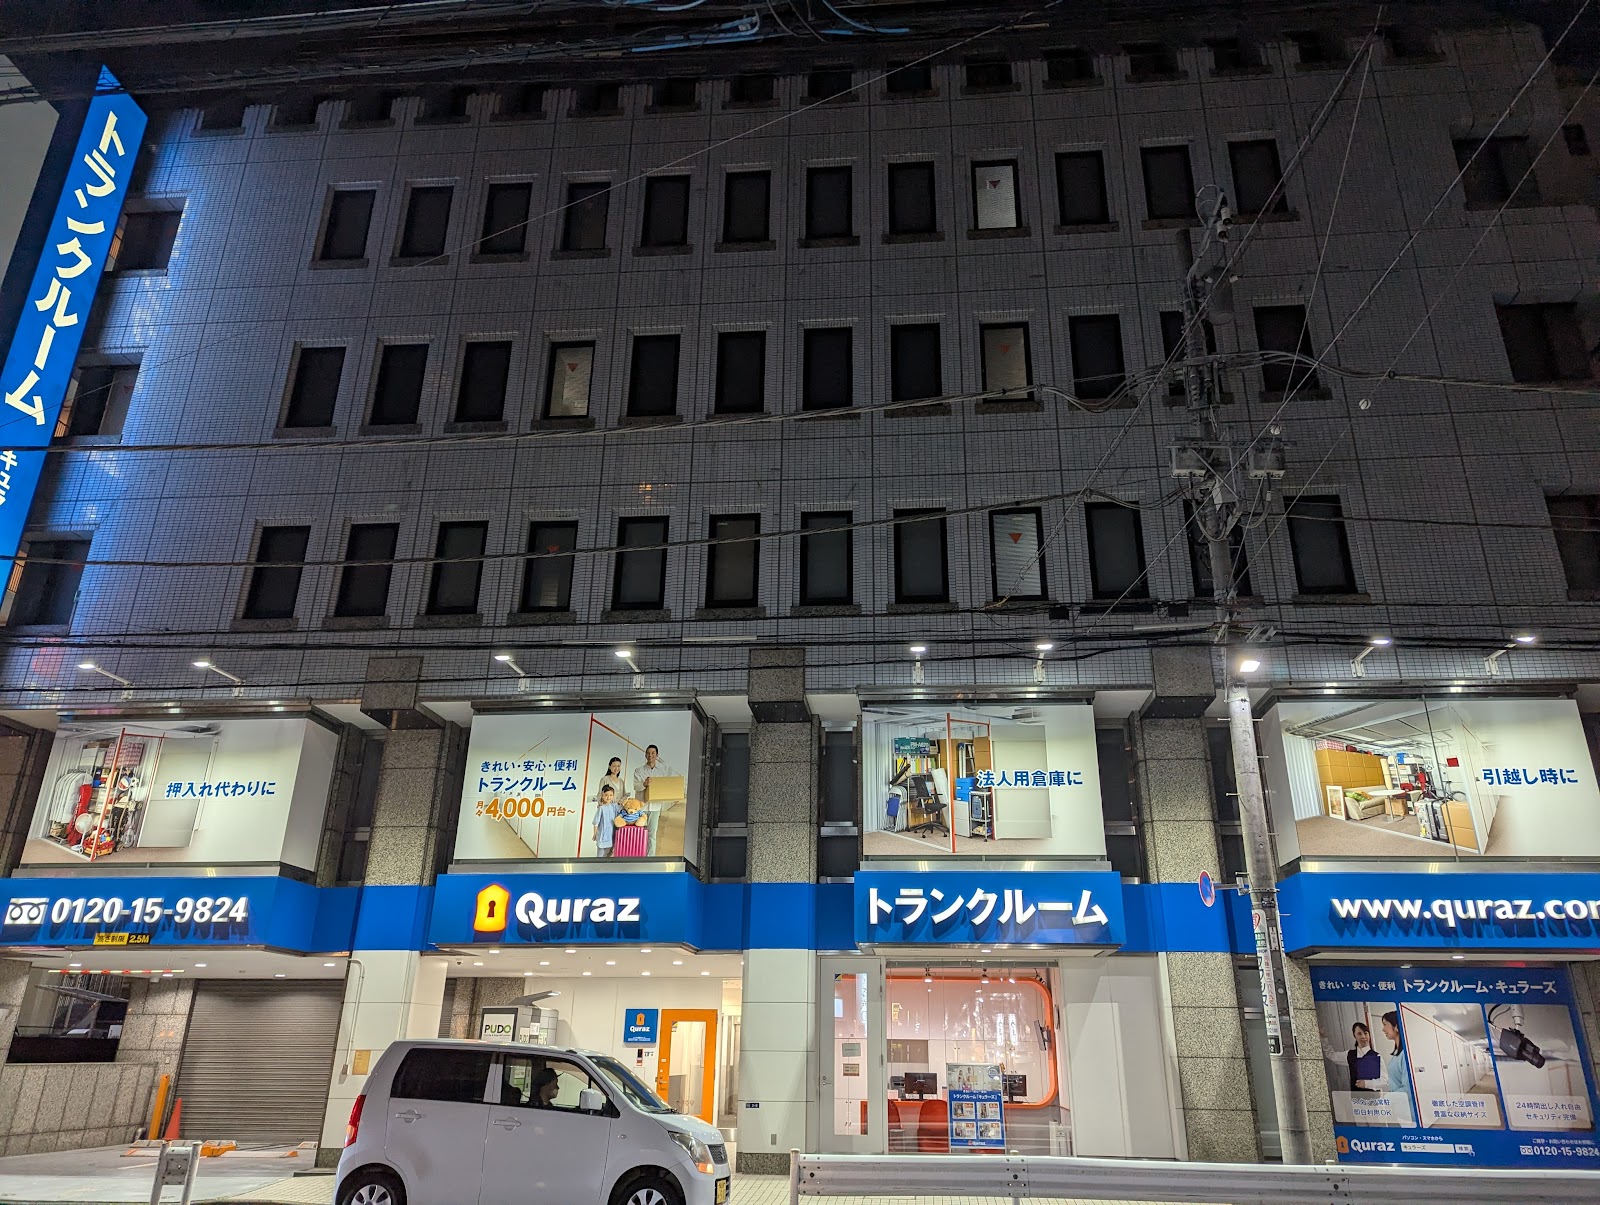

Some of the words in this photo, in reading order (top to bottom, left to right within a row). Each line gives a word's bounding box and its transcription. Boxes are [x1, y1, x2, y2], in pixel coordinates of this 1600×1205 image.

[5, 110, 125, 426] トランクルーム
[480, 759, 578, 773] きれい・安心・便利
[478, 776, 577, 793] トランクルーム
[977, 770, 1083, 788] 法人用倉庫に
[1482, 768, 1578, 786] 引越し時に
[165, 781, 277, 798] 押入れ代わりに
[51, 896, 250, 924] 0120-15-9824
[515, 892, 641, 930] Quraz
[868, 887, 1110, 926] トランクルーム
[129, 934, 150, 944] 2.5M
[1318, 980, 1396, 991] きれい・安心・便利
[1402, 979, 1558, 995] トランクルーム・キュラーズ
[484, 1024, 512, 1034] PUDO
[629, 1025, 651, 1033] Quraz
[1350, 1138, 1396, 1153] Quraz
[1533, 1145, 1600, 1157] 0120-15-9824
